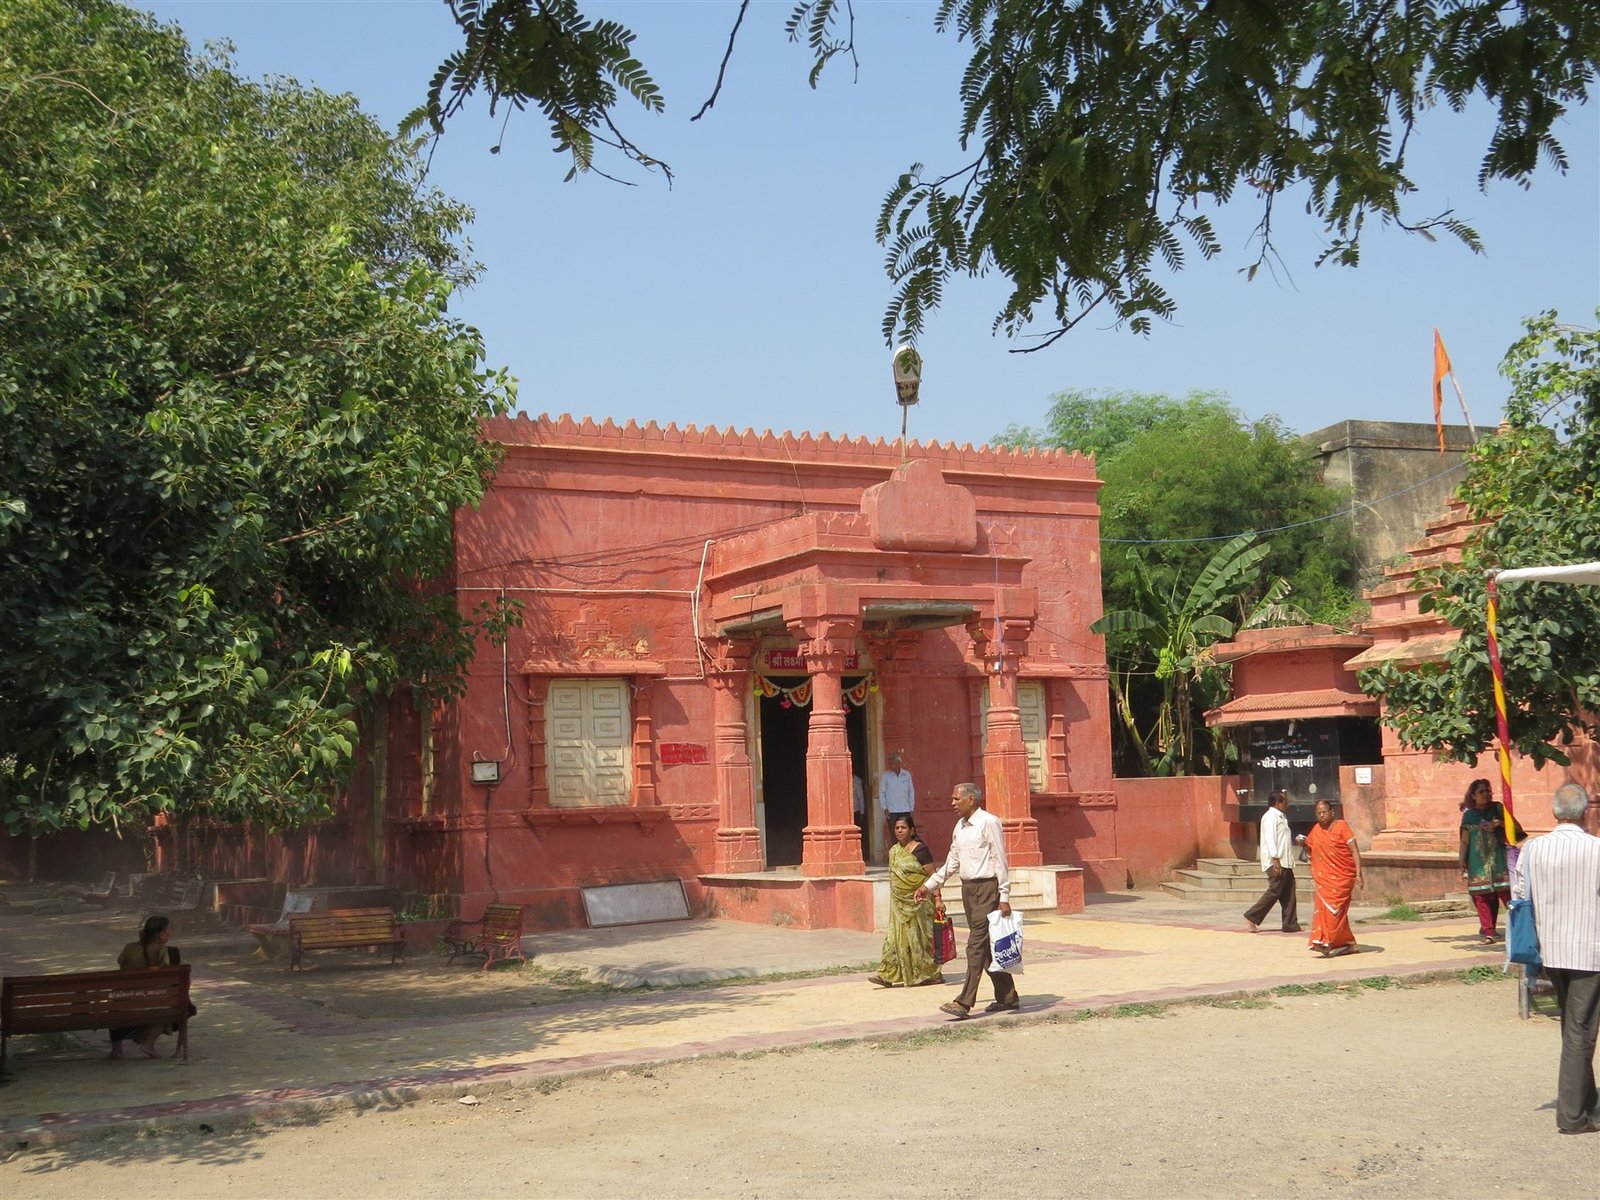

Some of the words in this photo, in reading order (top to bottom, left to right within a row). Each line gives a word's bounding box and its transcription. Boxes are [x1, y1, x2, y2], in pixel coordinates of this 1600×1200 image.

[772, 652, 782, 667] श्री
[1278, 758, 1290, 768] का
[1293, 754, 1314, 768] पानी
